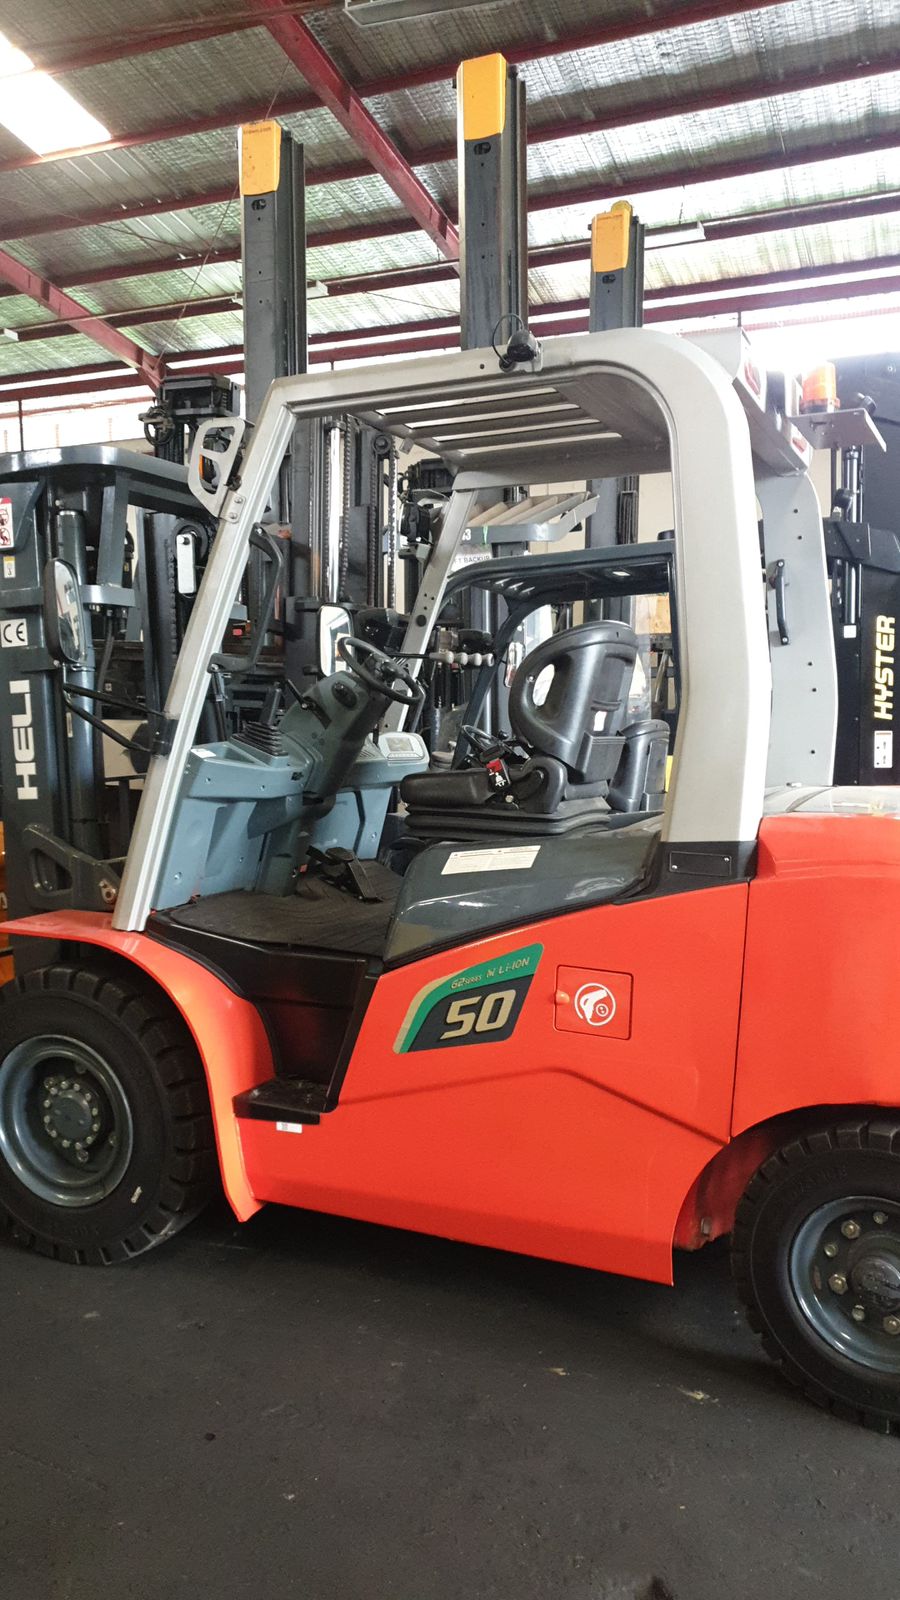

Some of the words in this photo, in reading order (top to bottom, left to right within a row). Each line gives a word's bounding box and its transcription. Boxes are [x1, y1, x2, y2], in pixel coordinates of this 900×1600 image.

[873, 614, 895, 721] HYSTER
[9, 679, 38, 800] HELI
[440, 989, 517, 1040] 50
